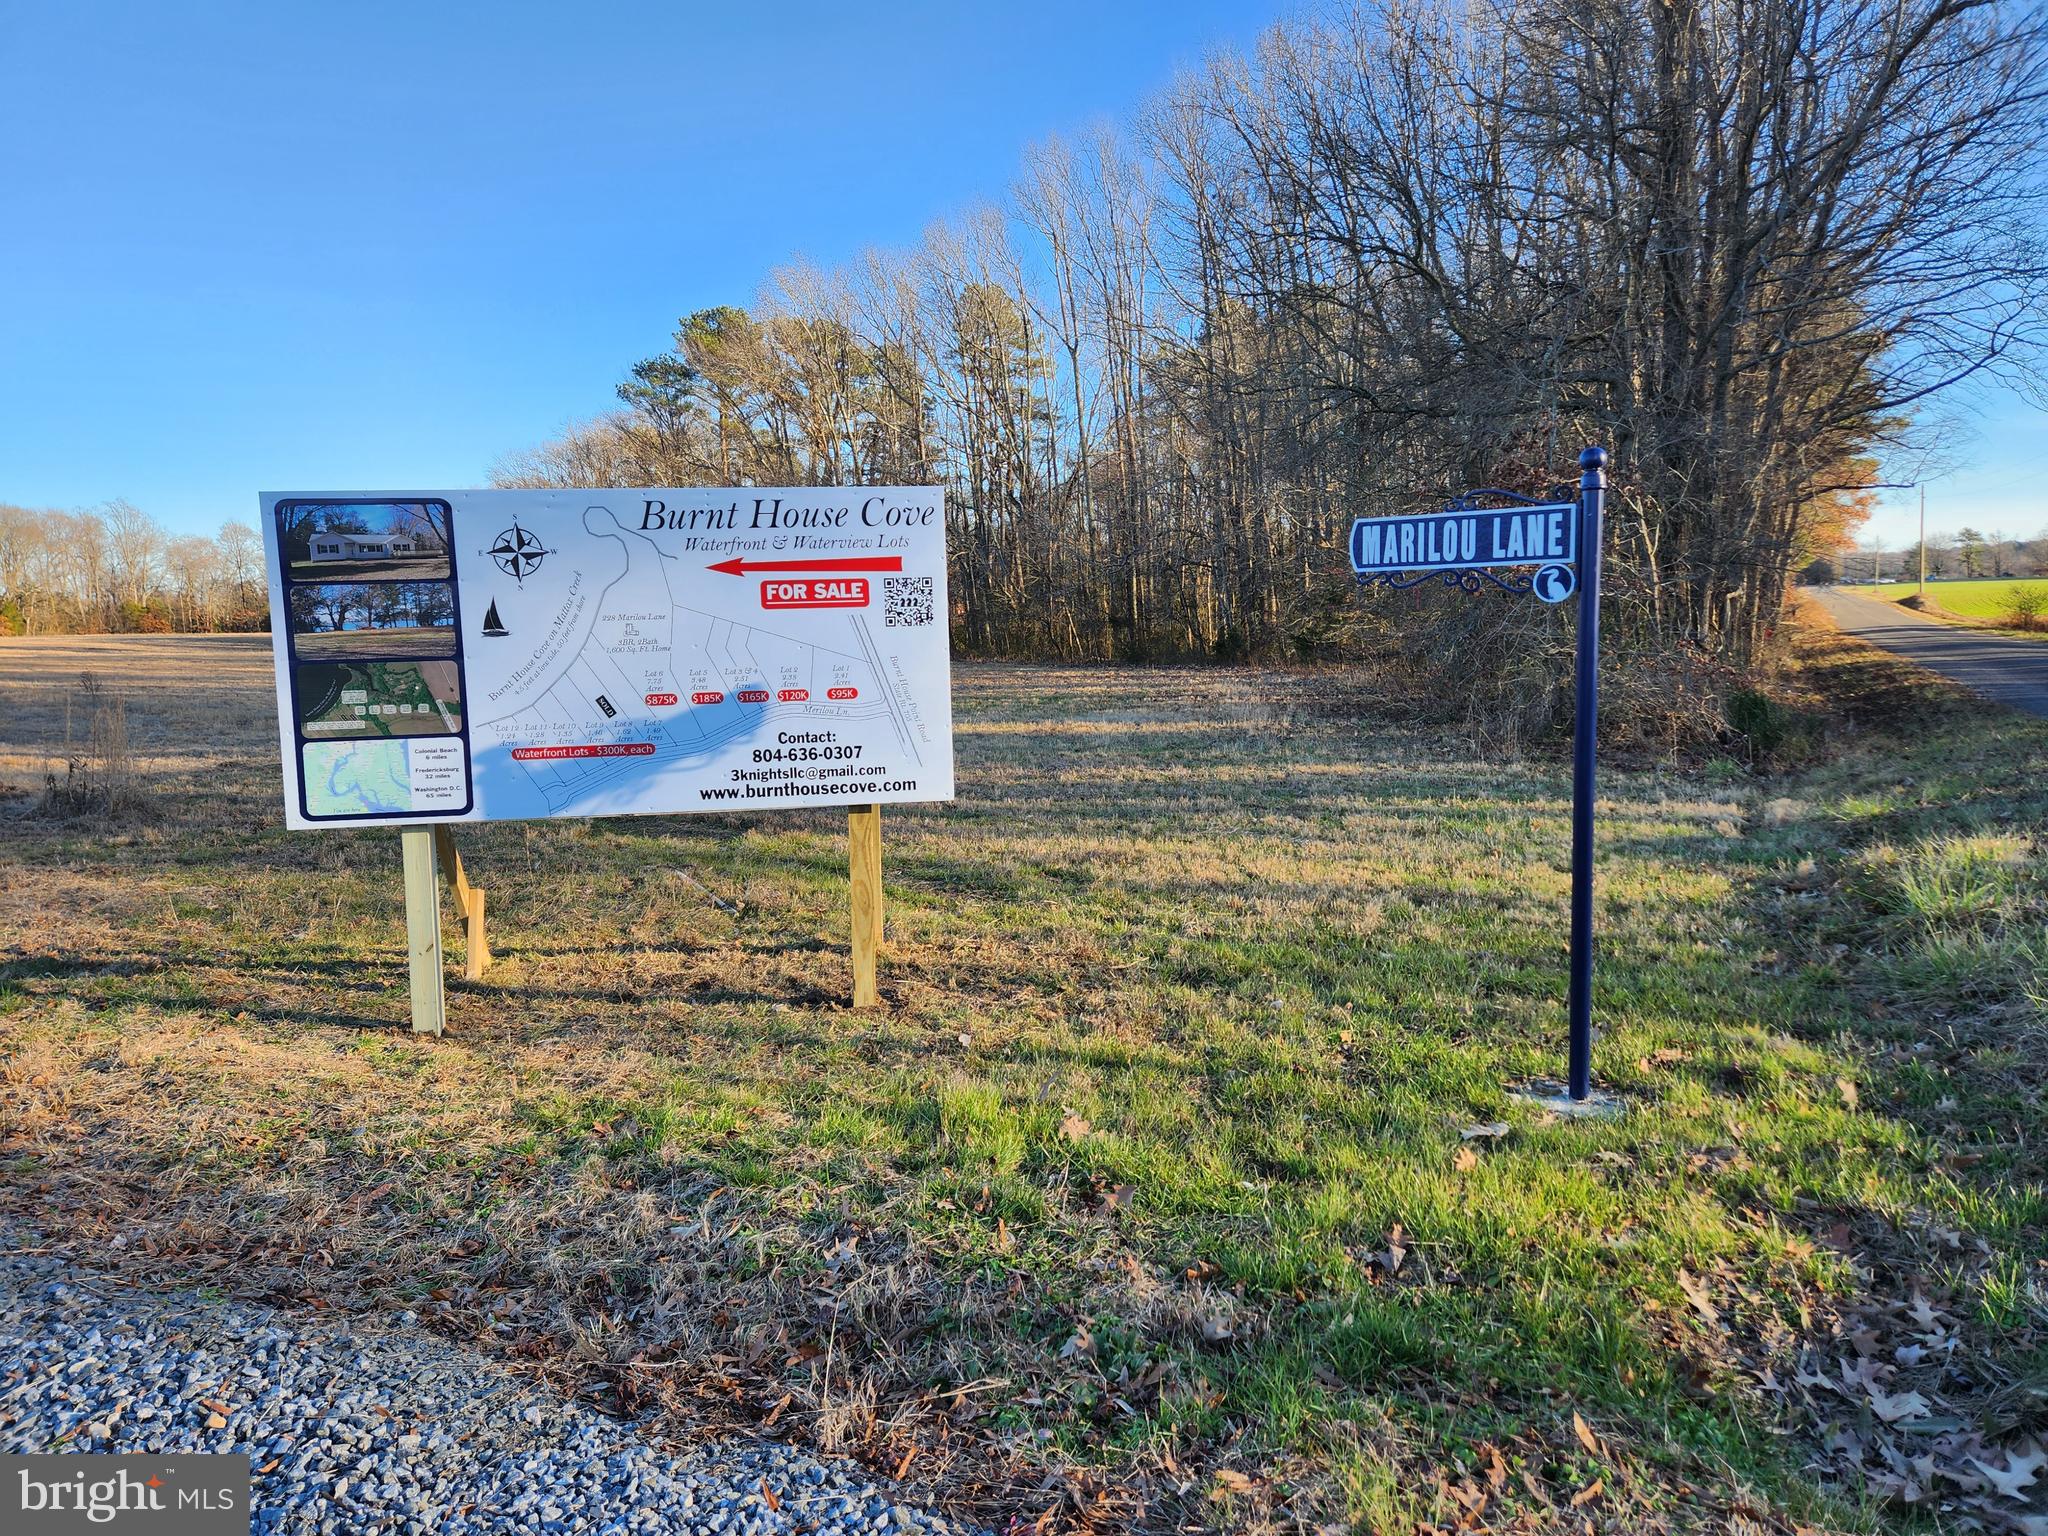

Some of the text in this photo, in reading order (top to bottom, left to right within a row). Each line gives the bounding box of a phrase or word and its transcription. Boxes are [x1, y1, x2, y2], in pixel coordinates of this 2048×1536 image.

[636, 497, 935, 530] Burnt House Cove
[685, 534, 910, 556] Waterfront & Waterview Lots
[1362, 512, 1563, 565] MARILOU LANE
[766, 582, 864, 600] FOR SALE
[488, 680, 513, 701] Burnt
[511, 659, 536, 682] House
[533, 640, 550, 660] Cove
[549, 628, 558, 640] on
[568, 570, 582, 596] Creek
[560, 627, 571, 643] feet
[566, 612, 578, 632] from
[646, 694, 676, 704] $875K
[693, 694, 722, 704] $185K
[740, 692, 768, 702] $165K
[778, 691, 807, 700] $120K
[832, 689, 854, 698] $95K
[890, 656, 904, 677] Burnt
[900, 680, 912, 700] House
[917, 724, 932, 743] Road
[600, 698, 614, 716] SOLD
[778, 732, 836, 744] Contact:
[516, 748, 566, 759] Waterfront
[569, 748, 588, 756] Lots
[597, 746, 628, 756] $300K,
[630, 745, 652, 754] each
[752, 746, 862, 763] 804-636-0307
[731, 765, 886, 782] 3knightsllc@gmail.com
[700, 780, 917, 800] www.burnthousecove.com
